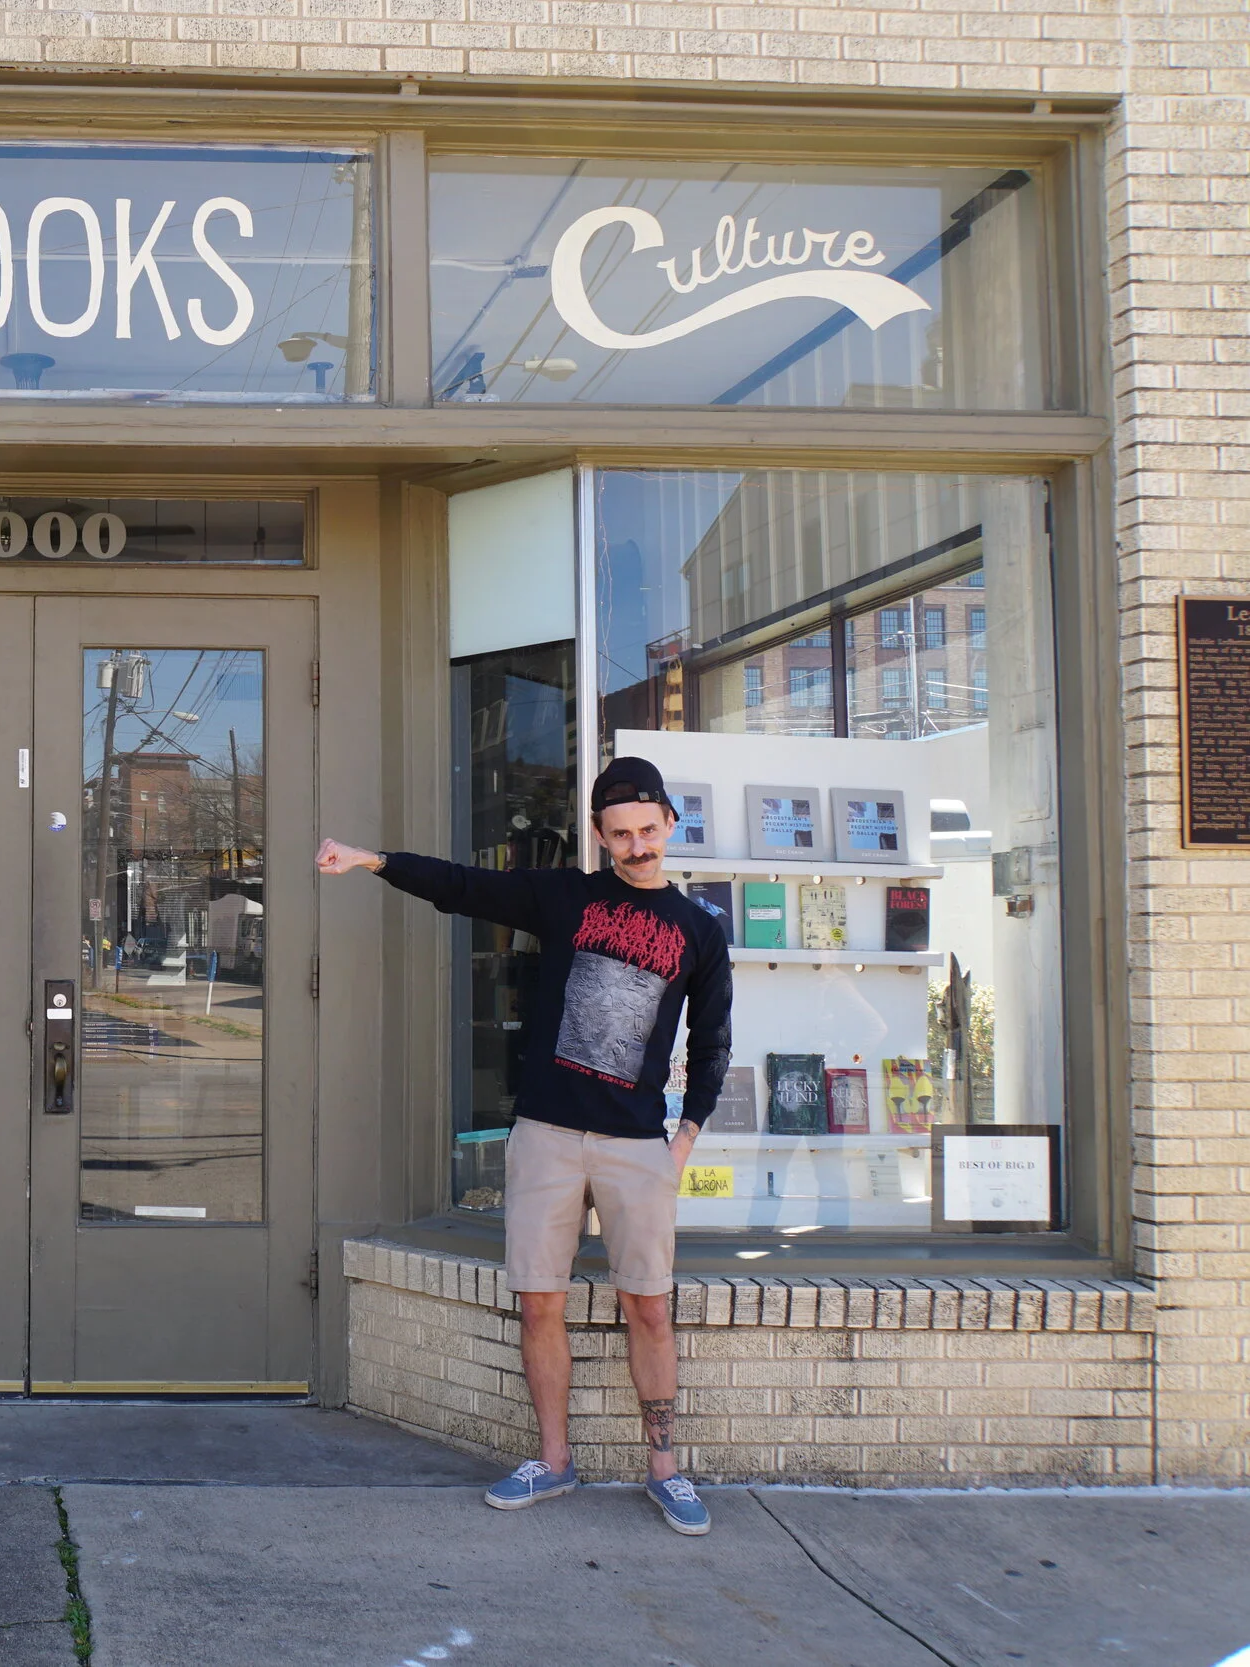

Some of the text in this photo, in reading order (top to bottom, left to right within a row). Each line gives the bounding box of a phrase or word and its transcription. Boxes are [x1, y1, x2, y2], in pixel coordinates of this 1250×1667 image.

[551, 205, 932, 350] Culture
[1227, 605, 1250, 621] Le
[890, 890, 927, 900] BLACK
[890, 900, 927, 910] FOREST
[777, 1080, 821, 1091] LUCKY
[831, 1088, 854, 1098] RED
[836, 1098, 868, 1109] ANTS
[959, 1161, 1036, 1170] BEST OF BIG D
[704, 1168, 716, 1177] LA
[688, 1179, 729, 1191] LLORONA
